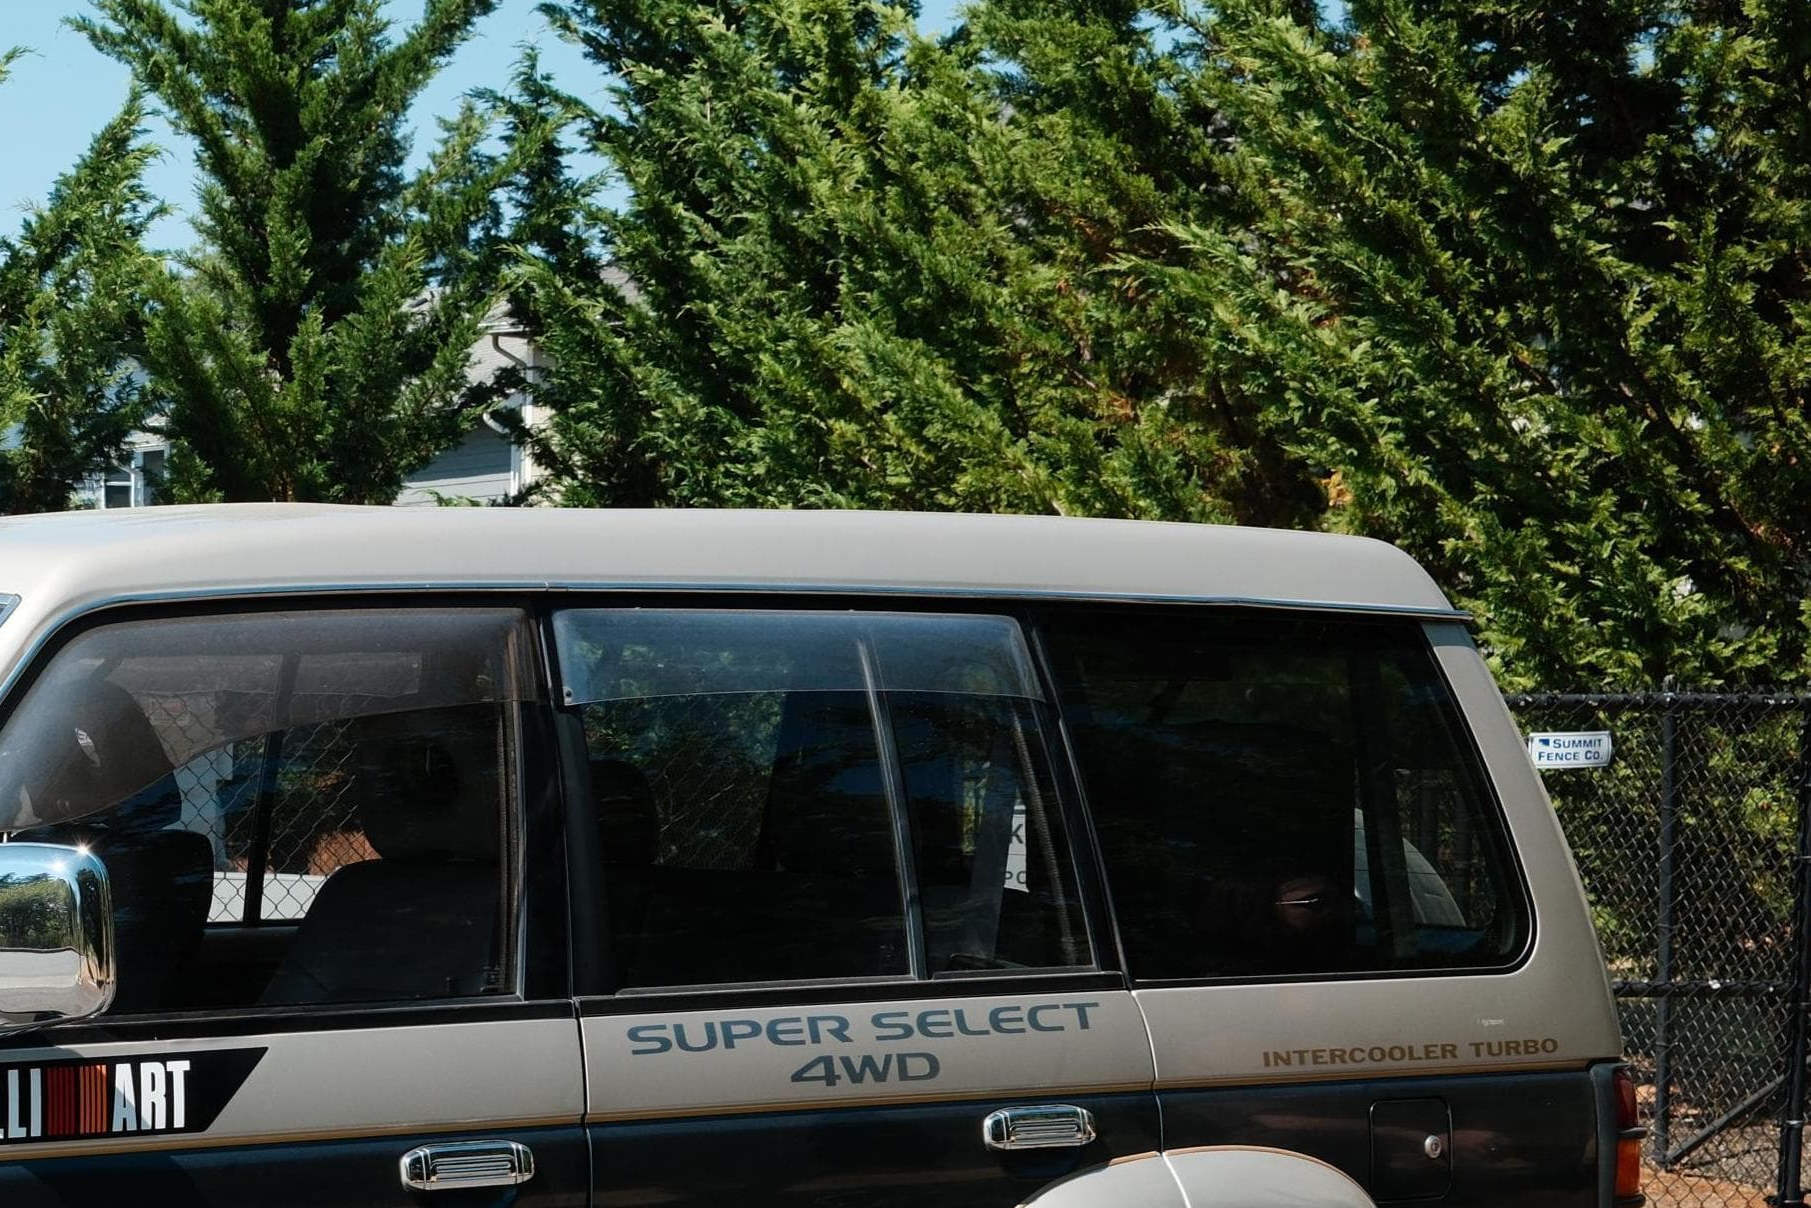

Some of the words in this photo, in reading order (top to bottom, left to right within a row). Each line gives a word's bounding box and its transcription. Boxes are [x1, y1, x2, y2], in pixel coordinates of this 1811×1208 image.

[1538, 751, 1580, 761] FENCE
[1553, 738, 1603, 749] SUMMIT
[626, 1014, 854, 1056] SUPER
[871, 1002, 1100, 1042] SELECT
[1262, 1043, 1458, 1067] INTERCOOLER
[1468, 1038, 1559, 1058] TURBO
[789, 1051, 941, 1087] 4WD
